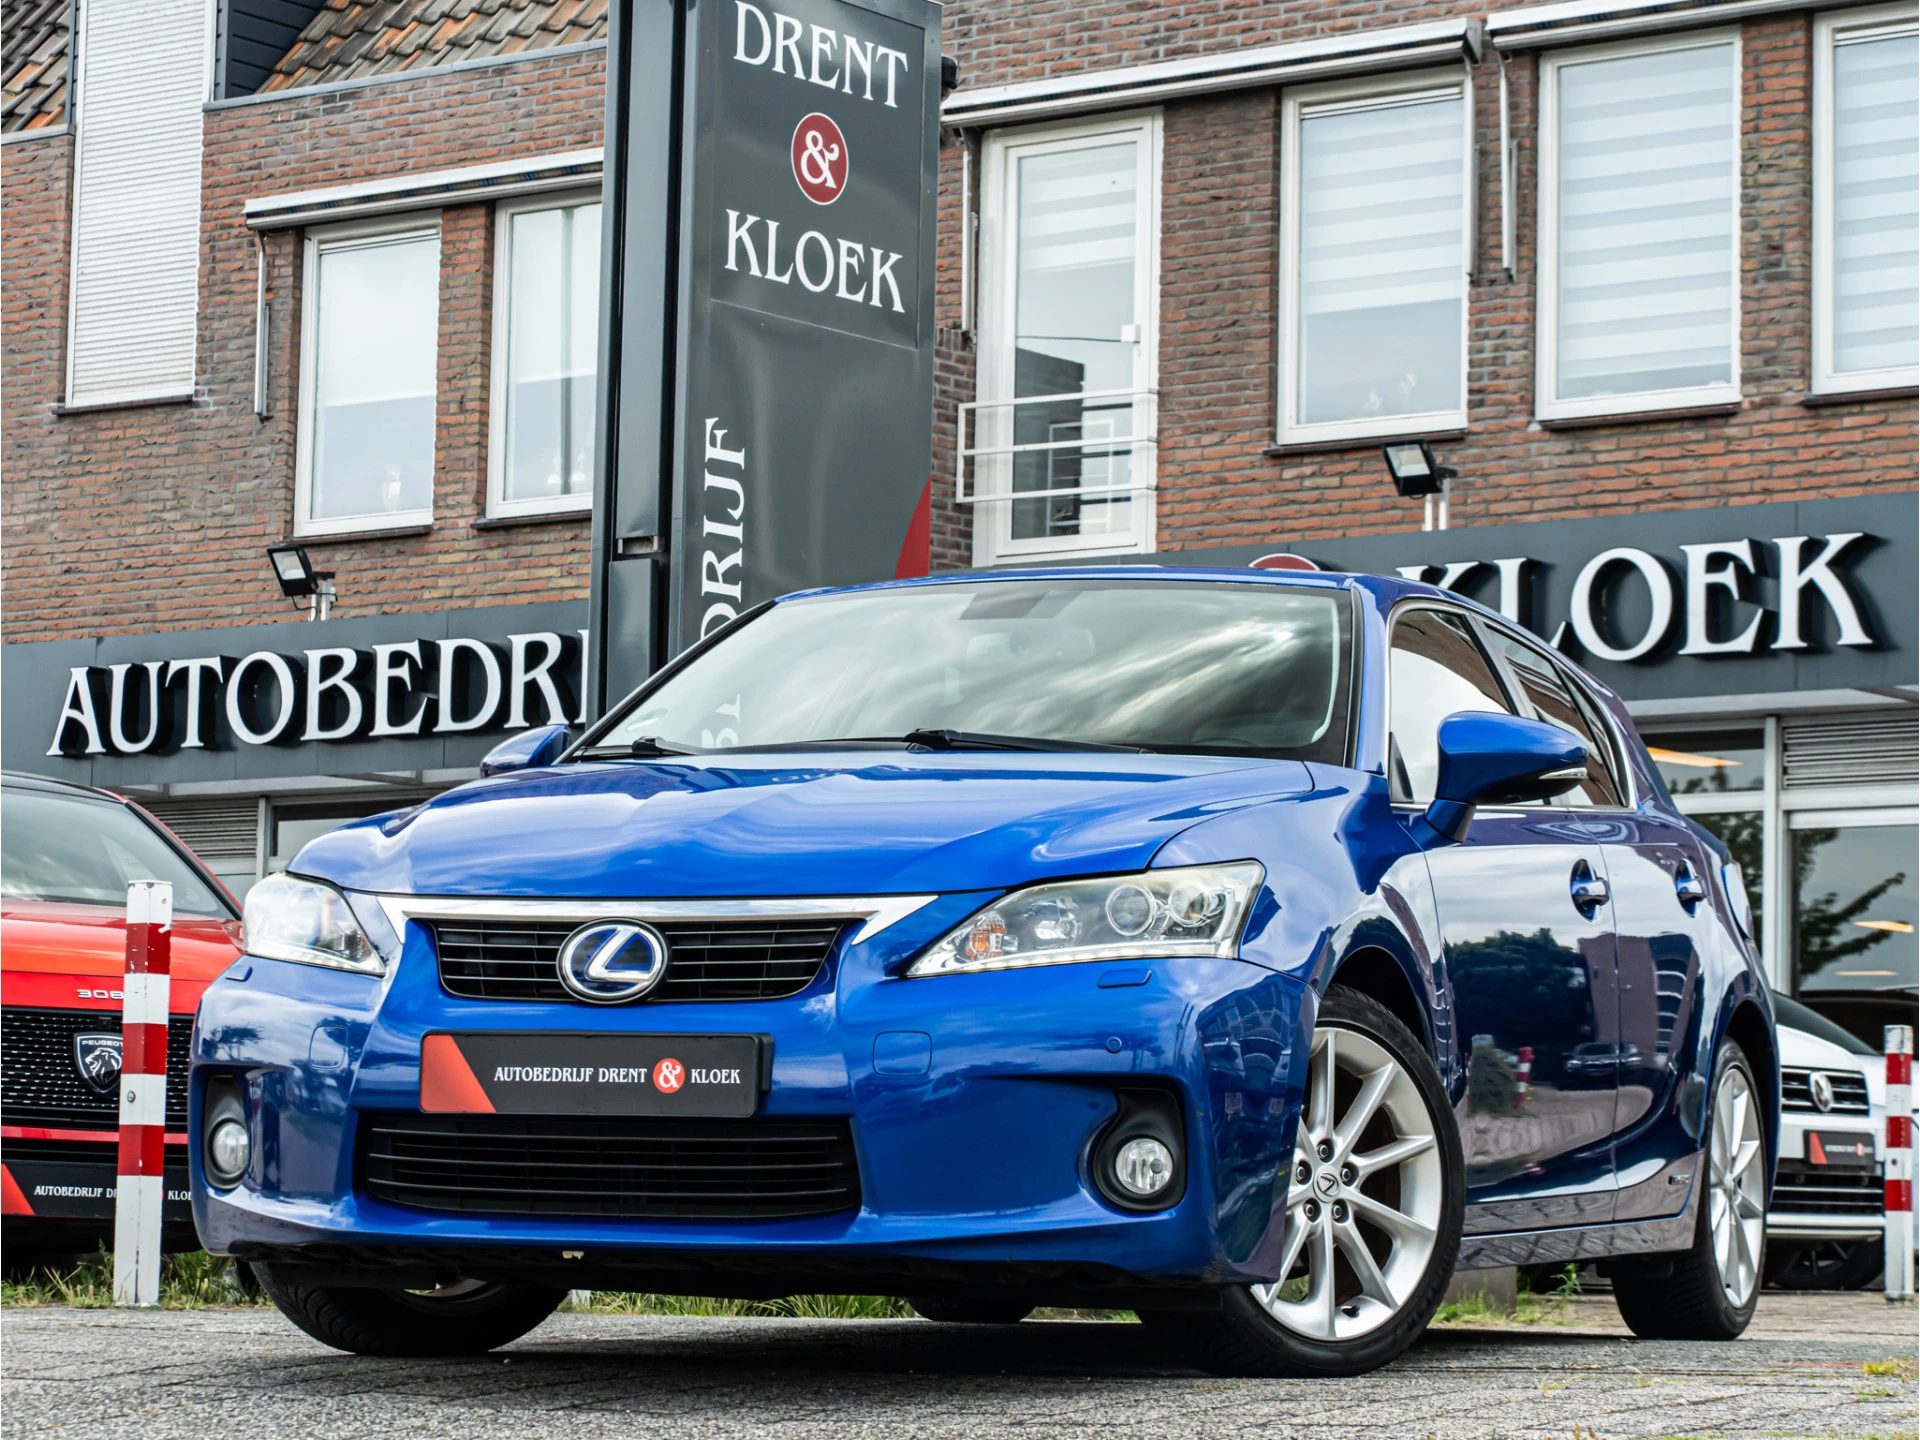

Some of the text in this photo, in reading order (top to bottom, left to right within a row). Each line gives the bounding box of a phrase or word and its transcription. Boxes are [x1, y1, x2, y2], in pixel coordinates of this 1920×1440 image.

[733, 1, 908, 107] DRENT
[800, 130, 839, 189] &
[725, 209, 905, 313] KLOEK
[1396, 532, 1873, 662] LOEK
[77, 989, 123, 999] 308
[494, 1061, 741, 1088] AUTOBEDRIJF DRENT & KLOEK
[34, 1186, 103, 1198] AUTOBEDRIJF
